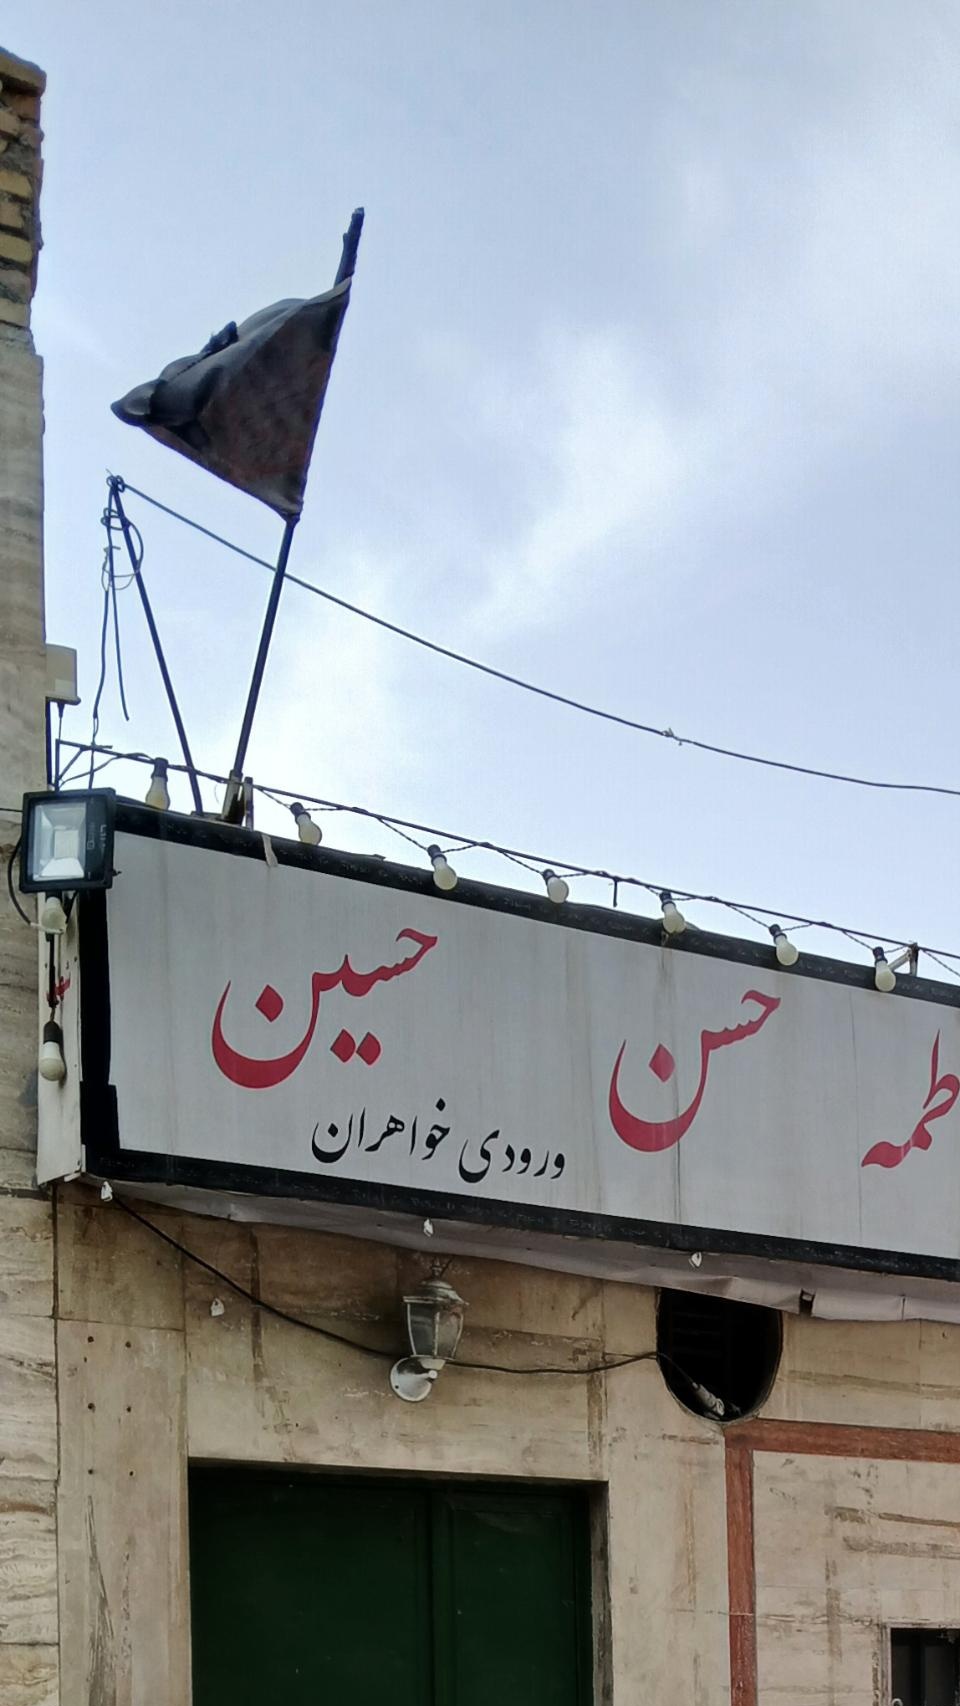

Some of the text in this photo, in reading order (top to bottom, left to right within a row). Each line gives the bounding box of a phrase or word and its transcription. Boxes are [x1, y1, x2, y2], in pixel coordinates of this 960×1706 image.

[211, 927, 439, 1090] حسین
[608, 989, 782, 1153] حسن
[311, 1097, 566, 1184] ورودی خواهران
